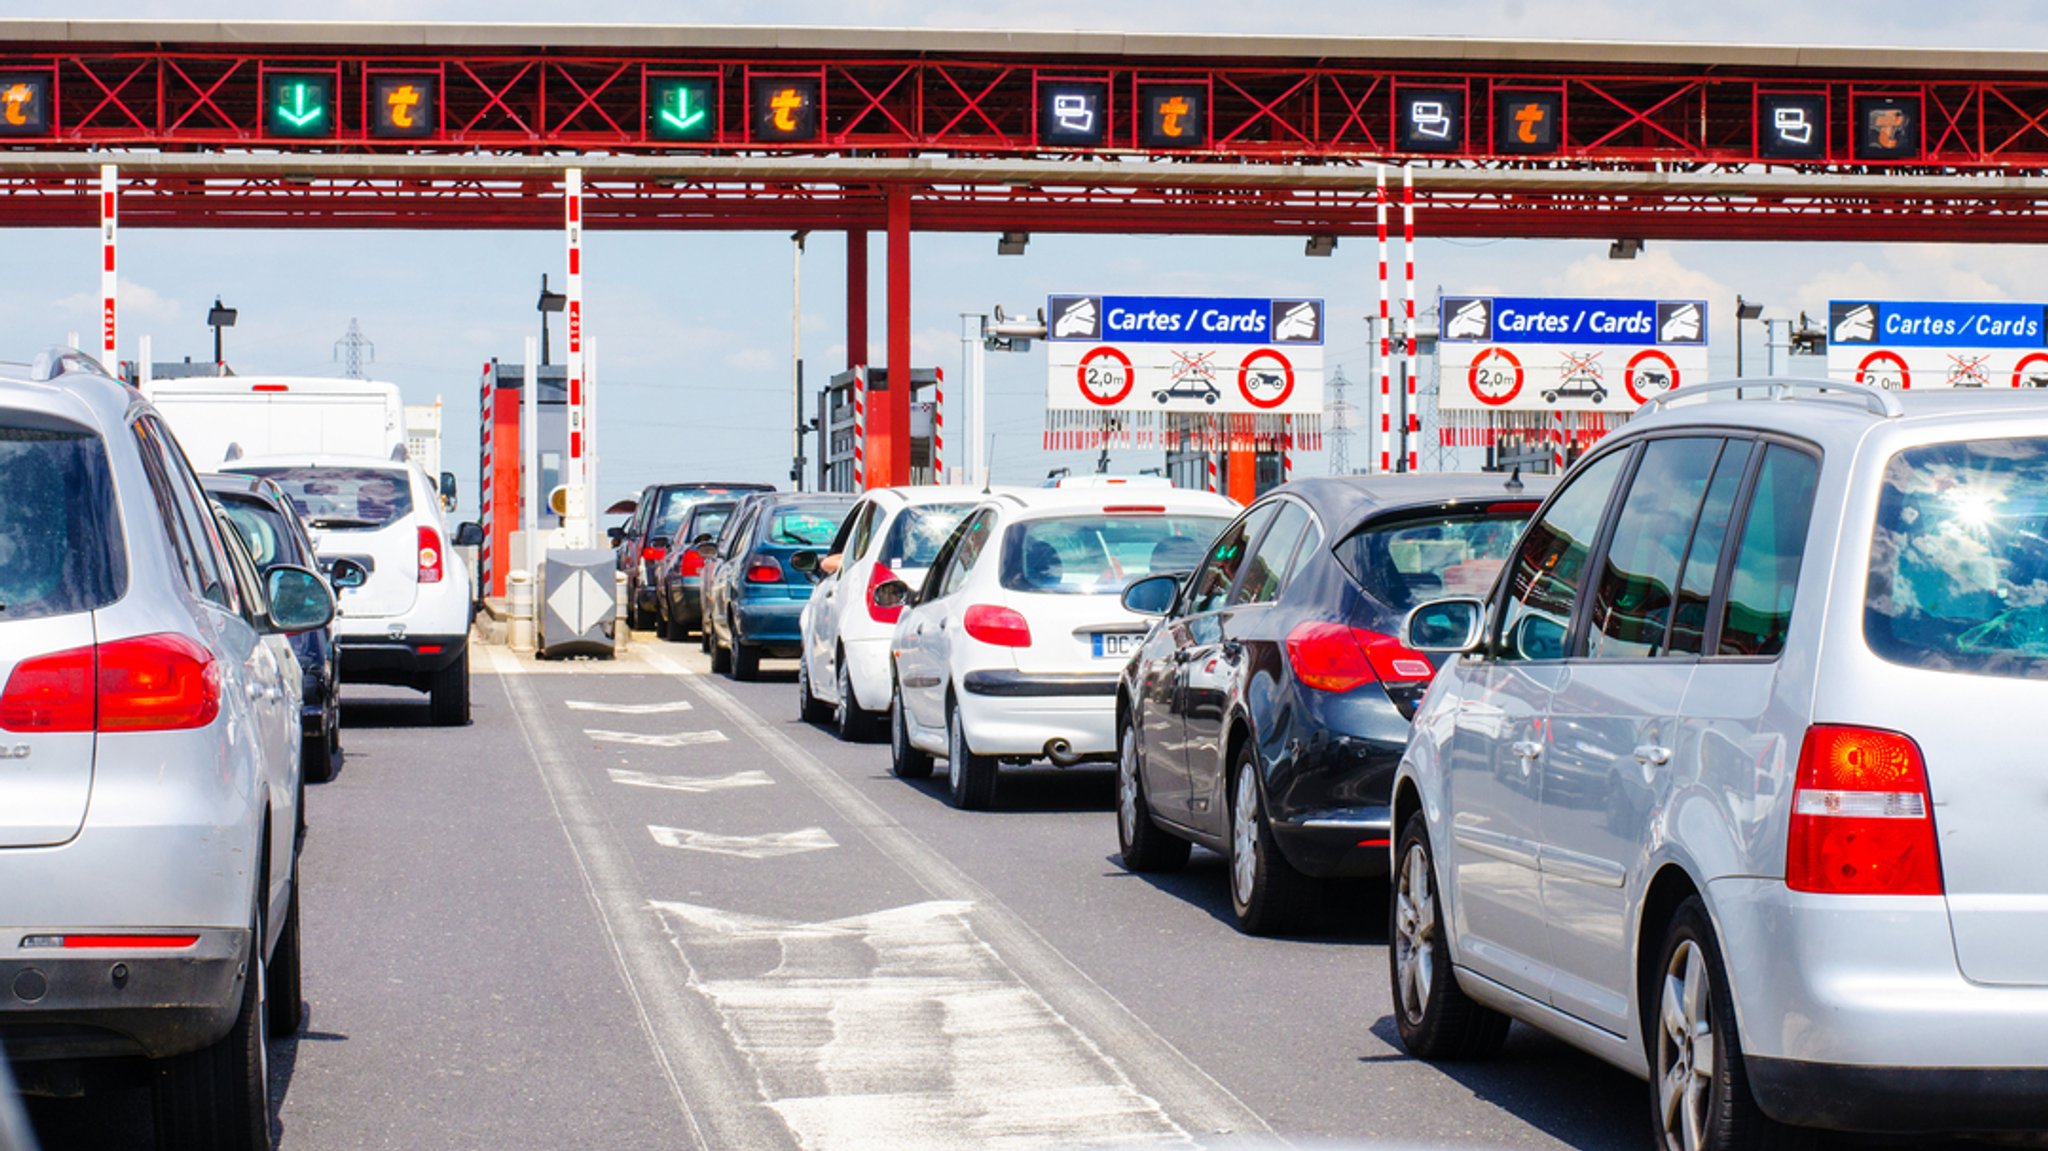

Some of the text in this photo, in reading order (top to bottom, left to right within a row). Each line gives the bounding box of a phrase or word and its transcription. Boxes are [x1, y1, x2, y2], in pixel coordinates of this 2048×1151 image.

[1, 84, 33, 126] t
[387, 84, 419, 129] t
[770, 88, 802, 132] t
[1159, 96, 1189, 137] t
[1515, 103, 1544, 143] t
[104, 308, 114, 341] STOP
[570, 310, 580, 344] STOP
[1108, 308, 1181, 331] Cartes
[1201, 309, 1266, 332] Cards
[1498, 309, 1570, 332] Cartes
[1589, 310, 1653, 333] Cards
[1886, 313, 1957, 335] Cartes
[1976, 315, 2038, 336] Cards
